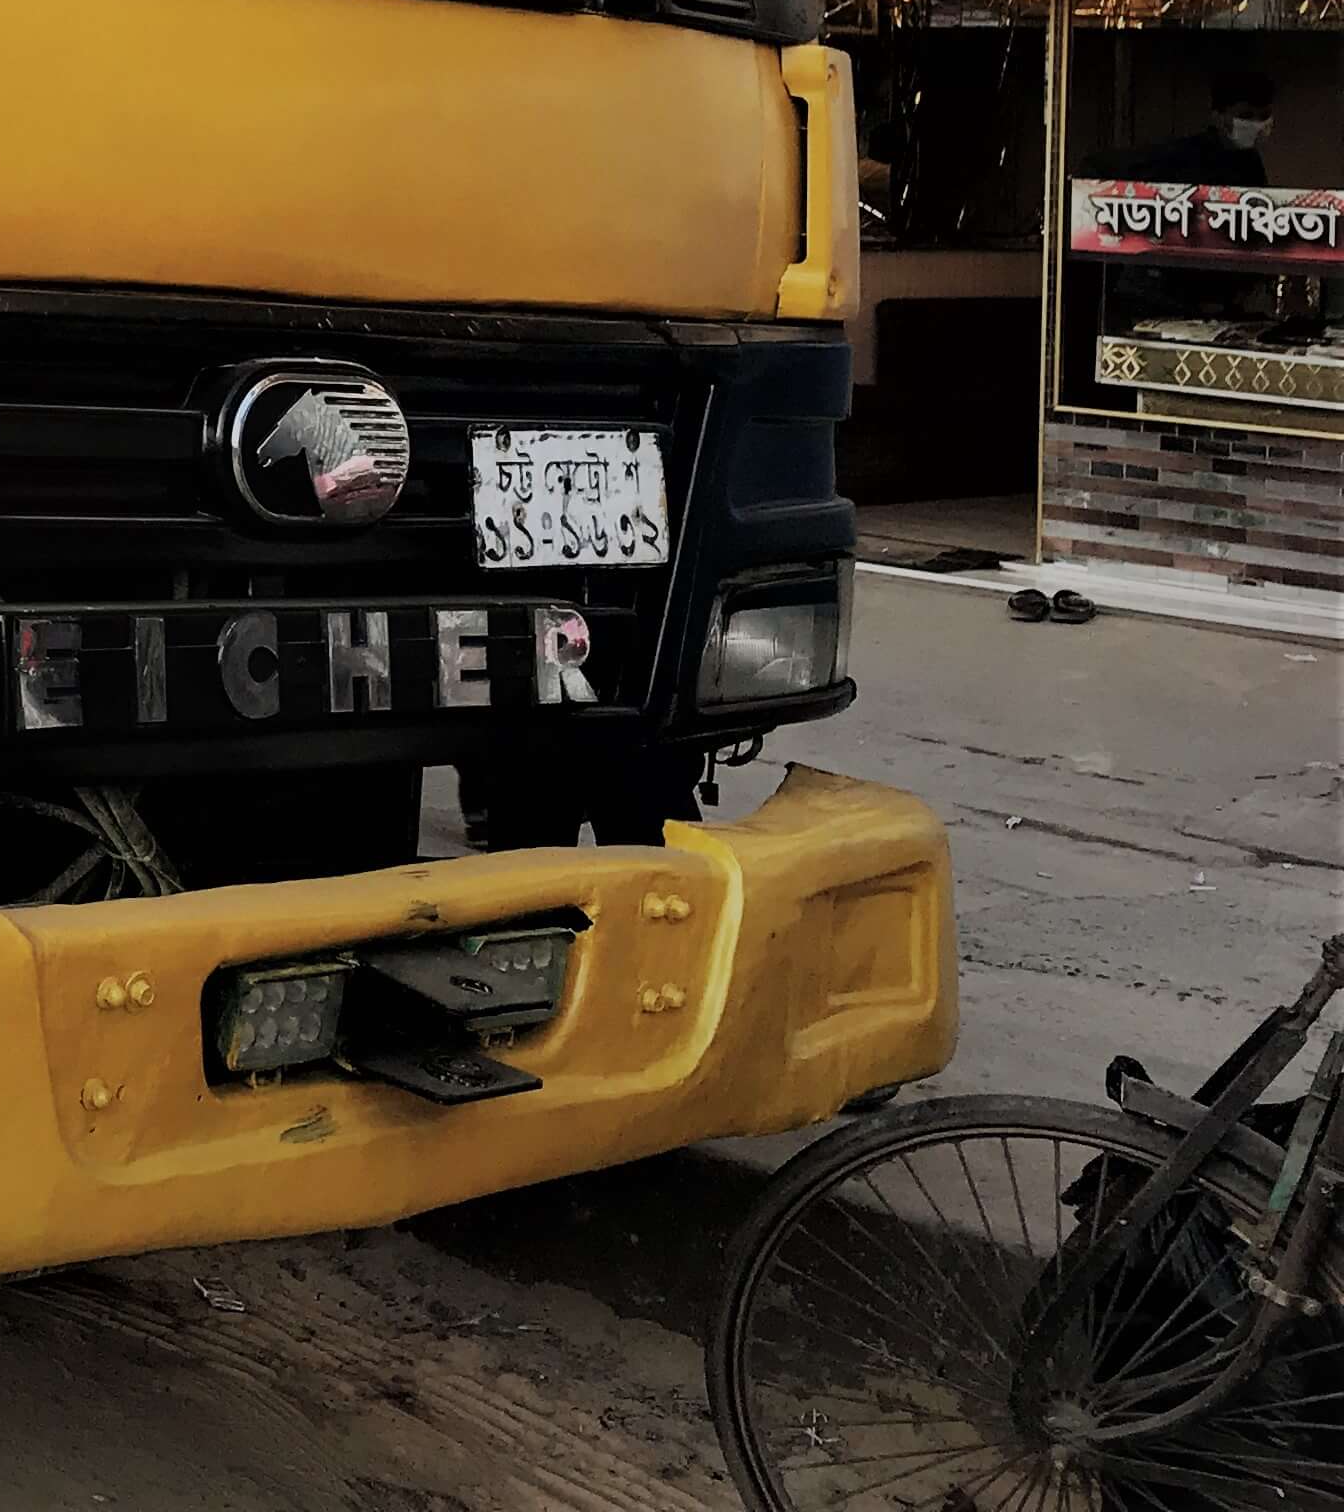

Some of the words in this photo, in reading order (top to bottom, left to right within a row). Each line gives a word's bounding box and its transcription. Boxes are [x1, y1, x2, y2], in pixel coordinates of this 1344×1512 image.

[1090, 186, 1198, 238] মডার্ণ
[1205, 192, 1340, 248] সঞ্চিতা
[14, 607, 600, 731] EICHER
